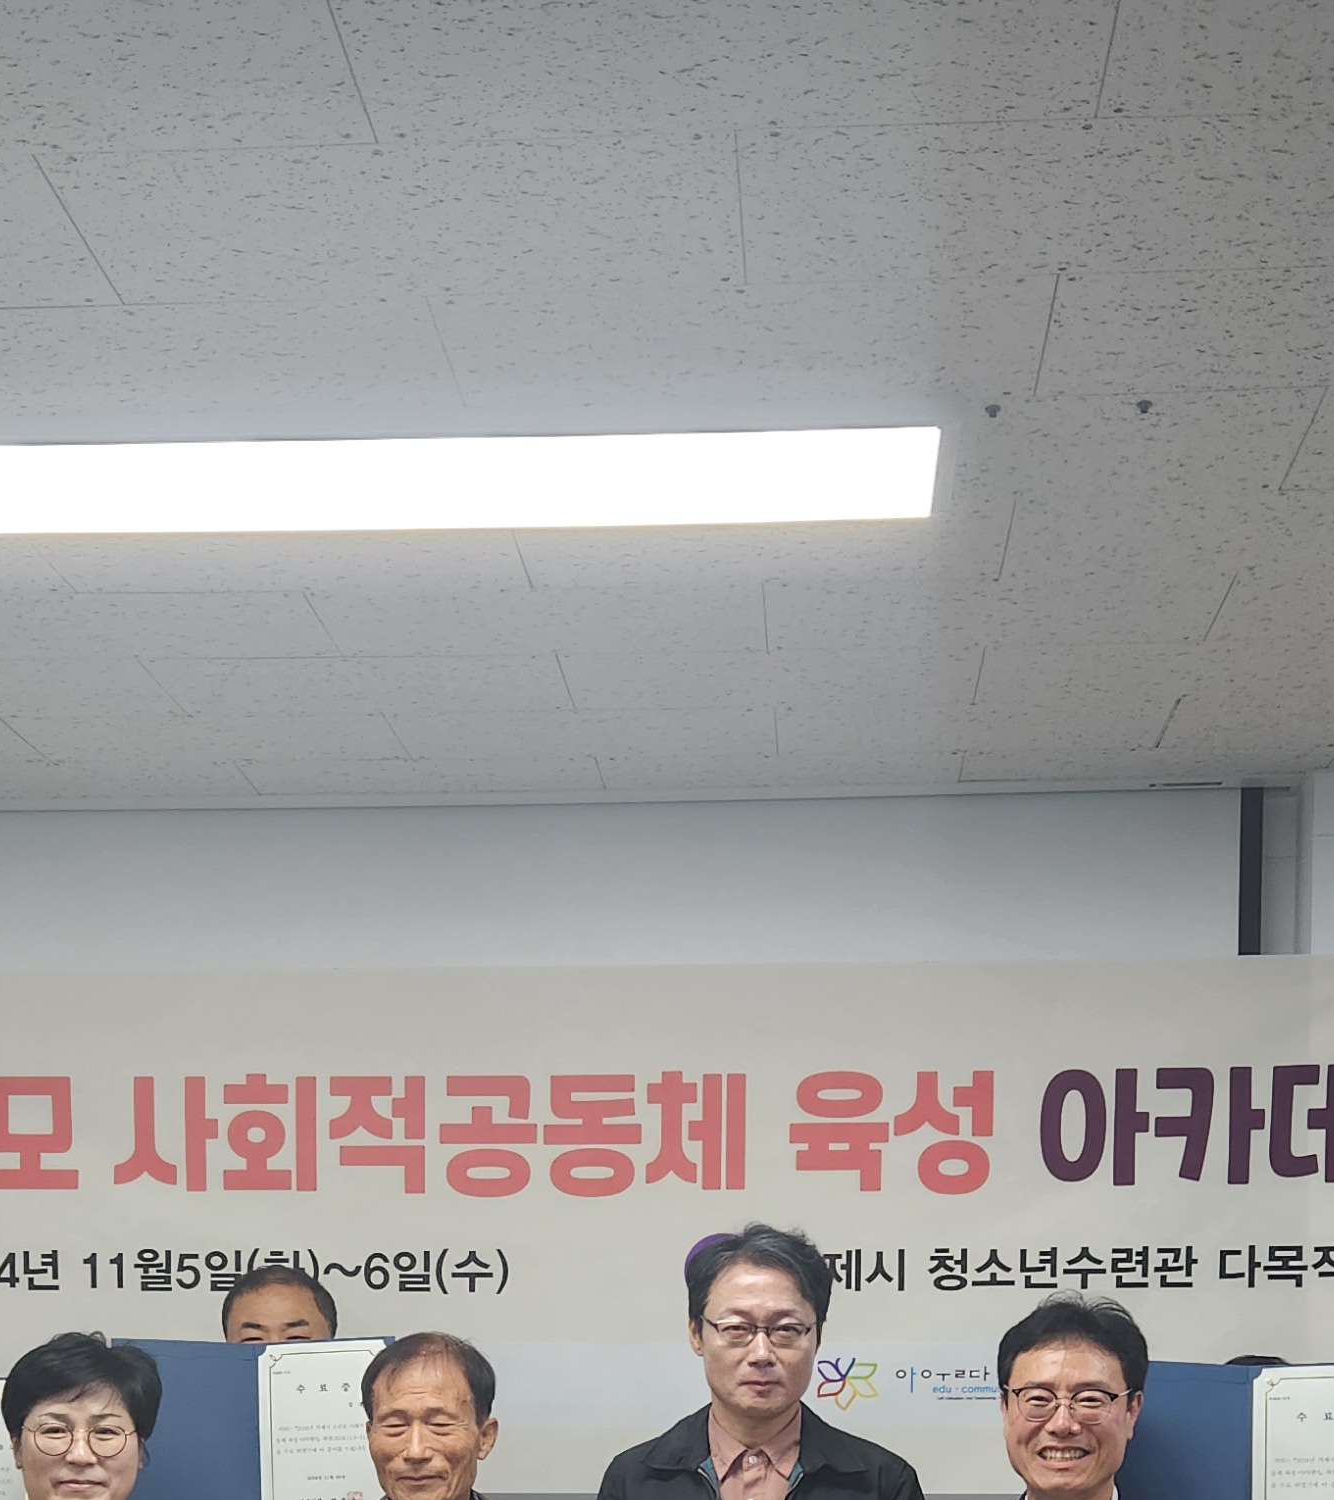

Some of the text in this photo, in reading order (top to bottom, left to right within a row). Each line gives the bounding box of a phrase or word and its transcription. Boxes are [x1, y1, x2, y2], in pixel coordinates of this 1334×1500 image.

[113, 1070, 746, 1197] 사회적공동체
[789, 1069, 995, 1196] 육성
[928, 1247, 1198, 1290] 청소년수련관
